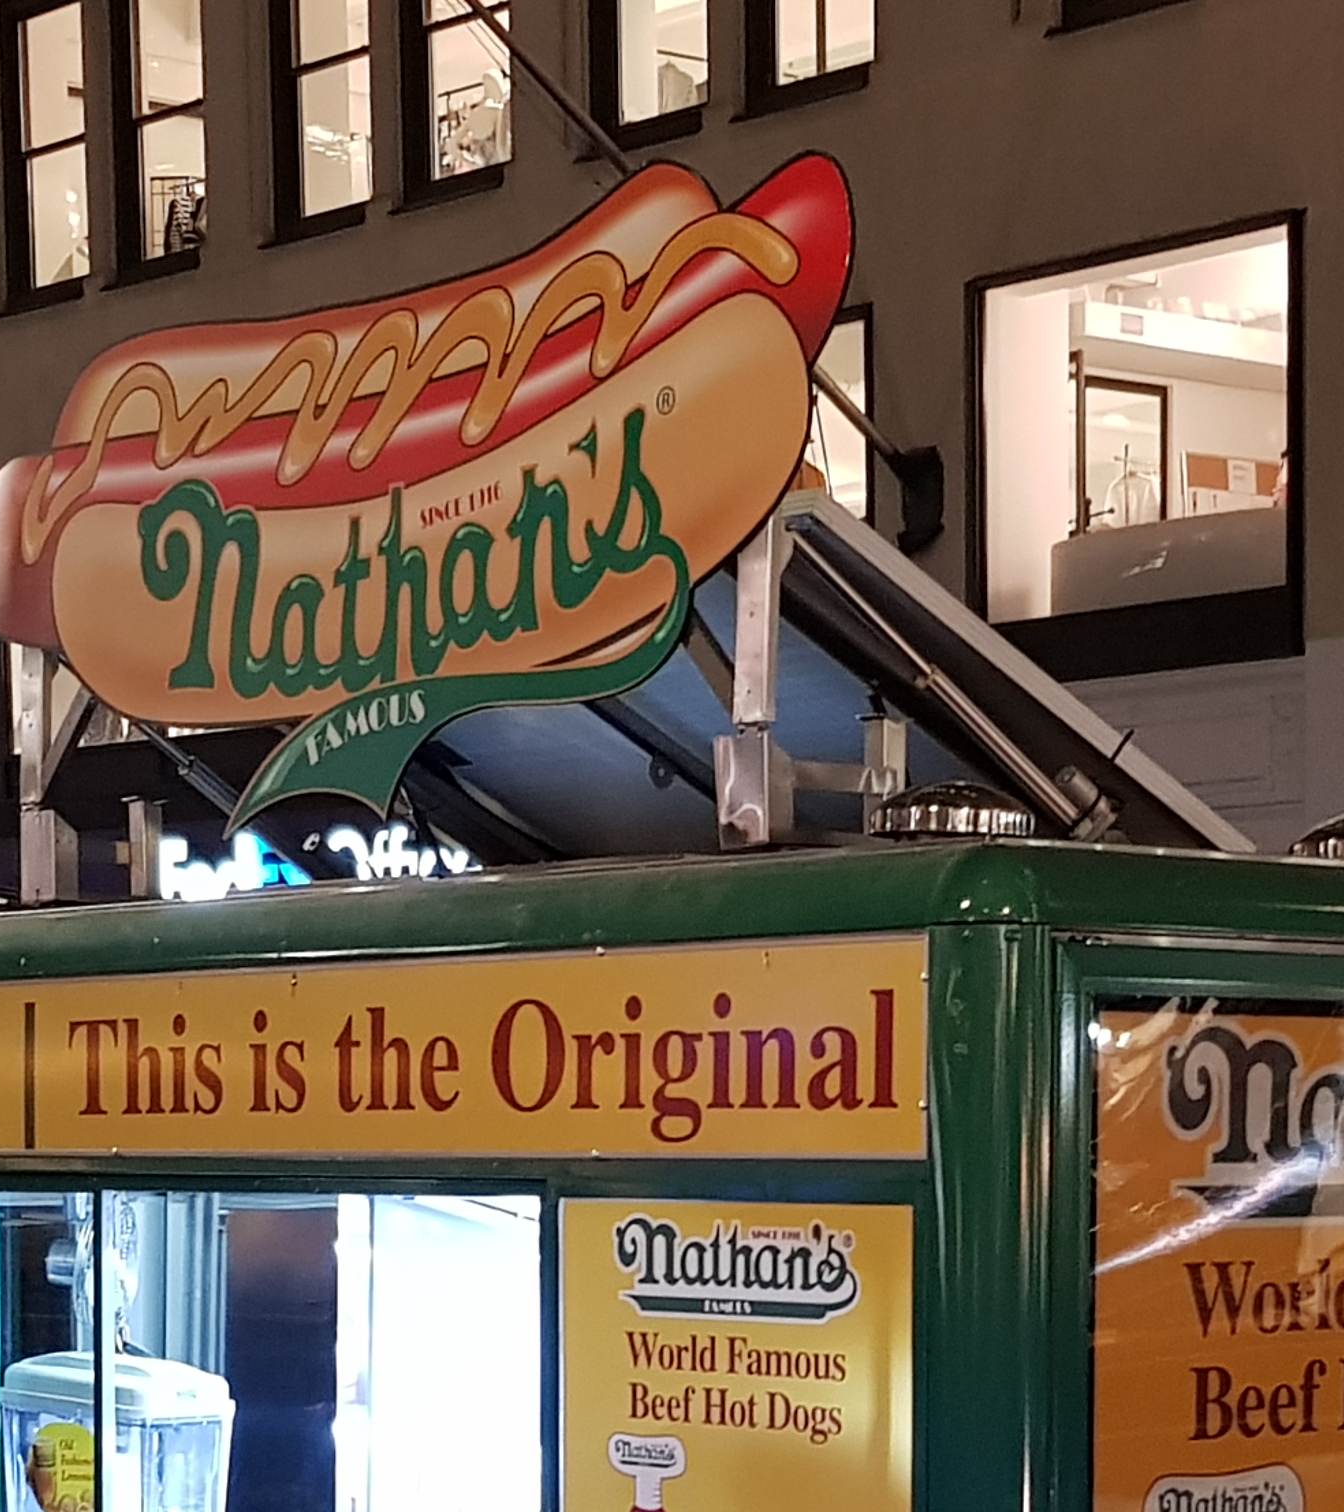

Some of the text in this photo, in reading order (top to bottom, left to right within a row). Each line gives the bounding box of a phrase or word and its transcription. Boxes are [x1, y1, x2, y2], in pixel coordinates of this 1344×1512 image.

[419, 480, 502, 530] SINCE 1916
[138, 402, 678, 702] Nathan's
[305, 689, 427, 766] FAMOUS
[69, 988, 898, 1143] This is the Original
[616, 1218, 848, 1293] Nathan's
[626, 1331, 847, 1382] World Famous
[629, 1382, 843, 1444] Beef Hot Dogs
[1187, 1359, 1326, 1441] Beef
